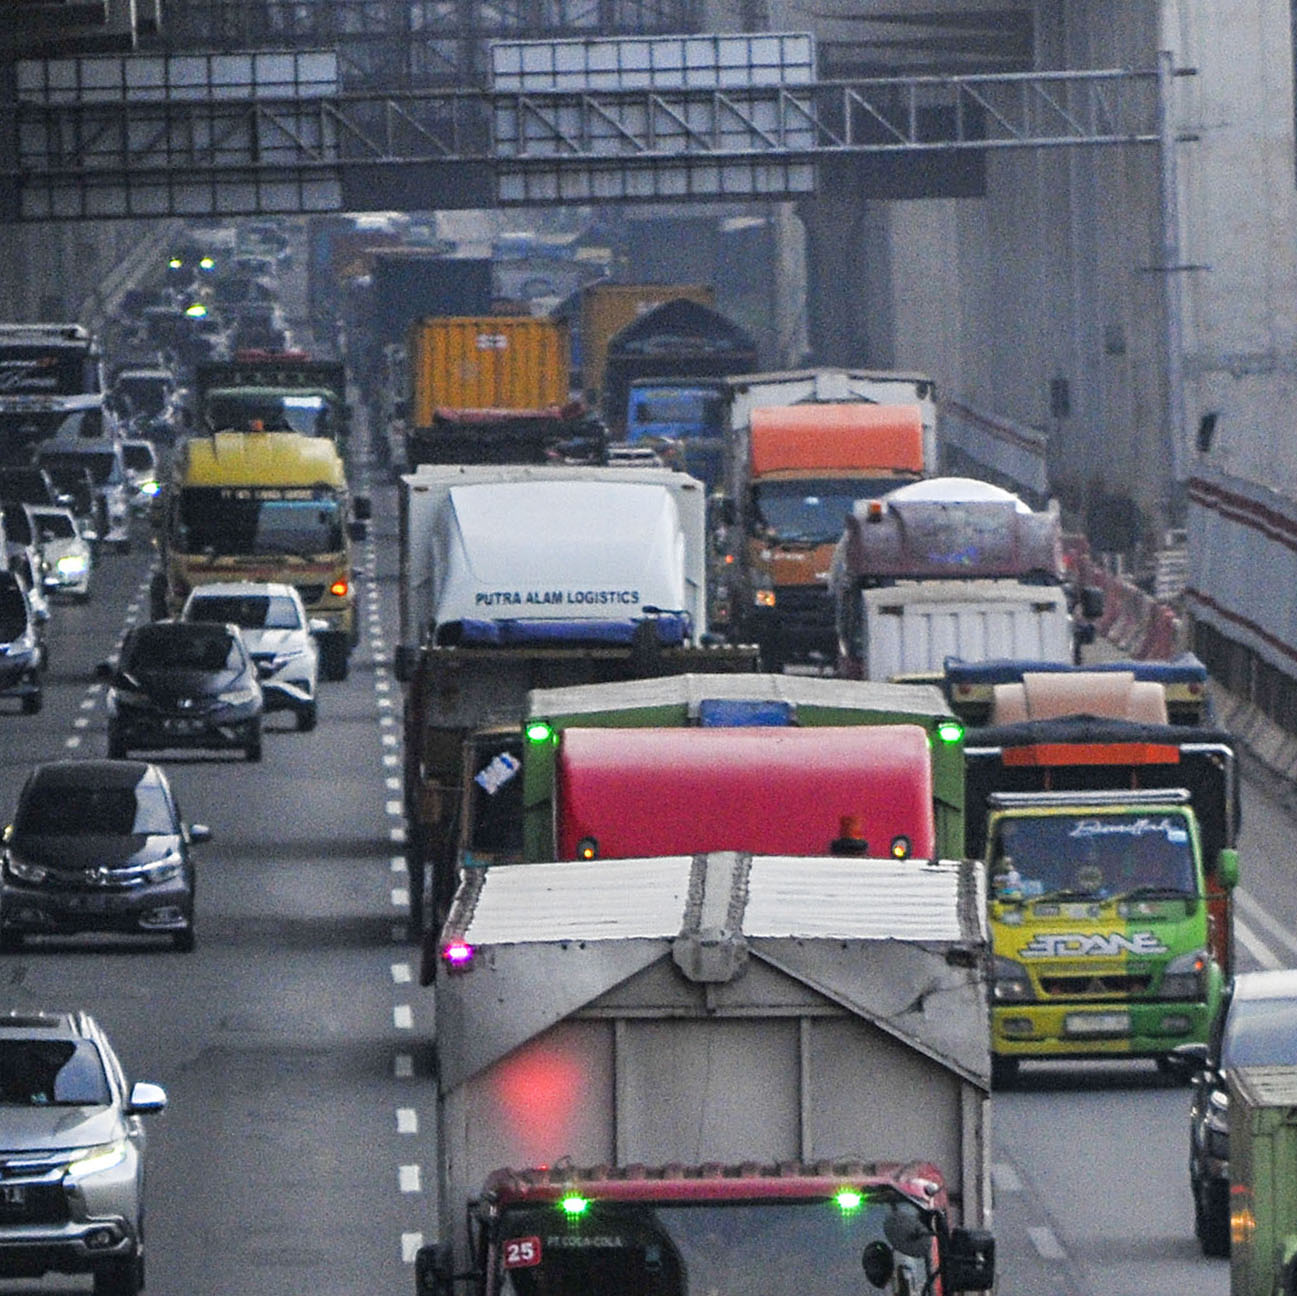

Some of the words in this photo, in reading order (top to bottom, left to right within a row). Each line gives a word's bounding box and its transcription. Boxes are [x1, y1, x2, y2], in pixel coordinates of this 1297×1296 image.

[476, 593, 521, 604] PUTRA
[527, 592, 562, 603] ALAM
[568, 591, 639, 603] LOGISTICS
[508, 1243, 534, 1261] 25
